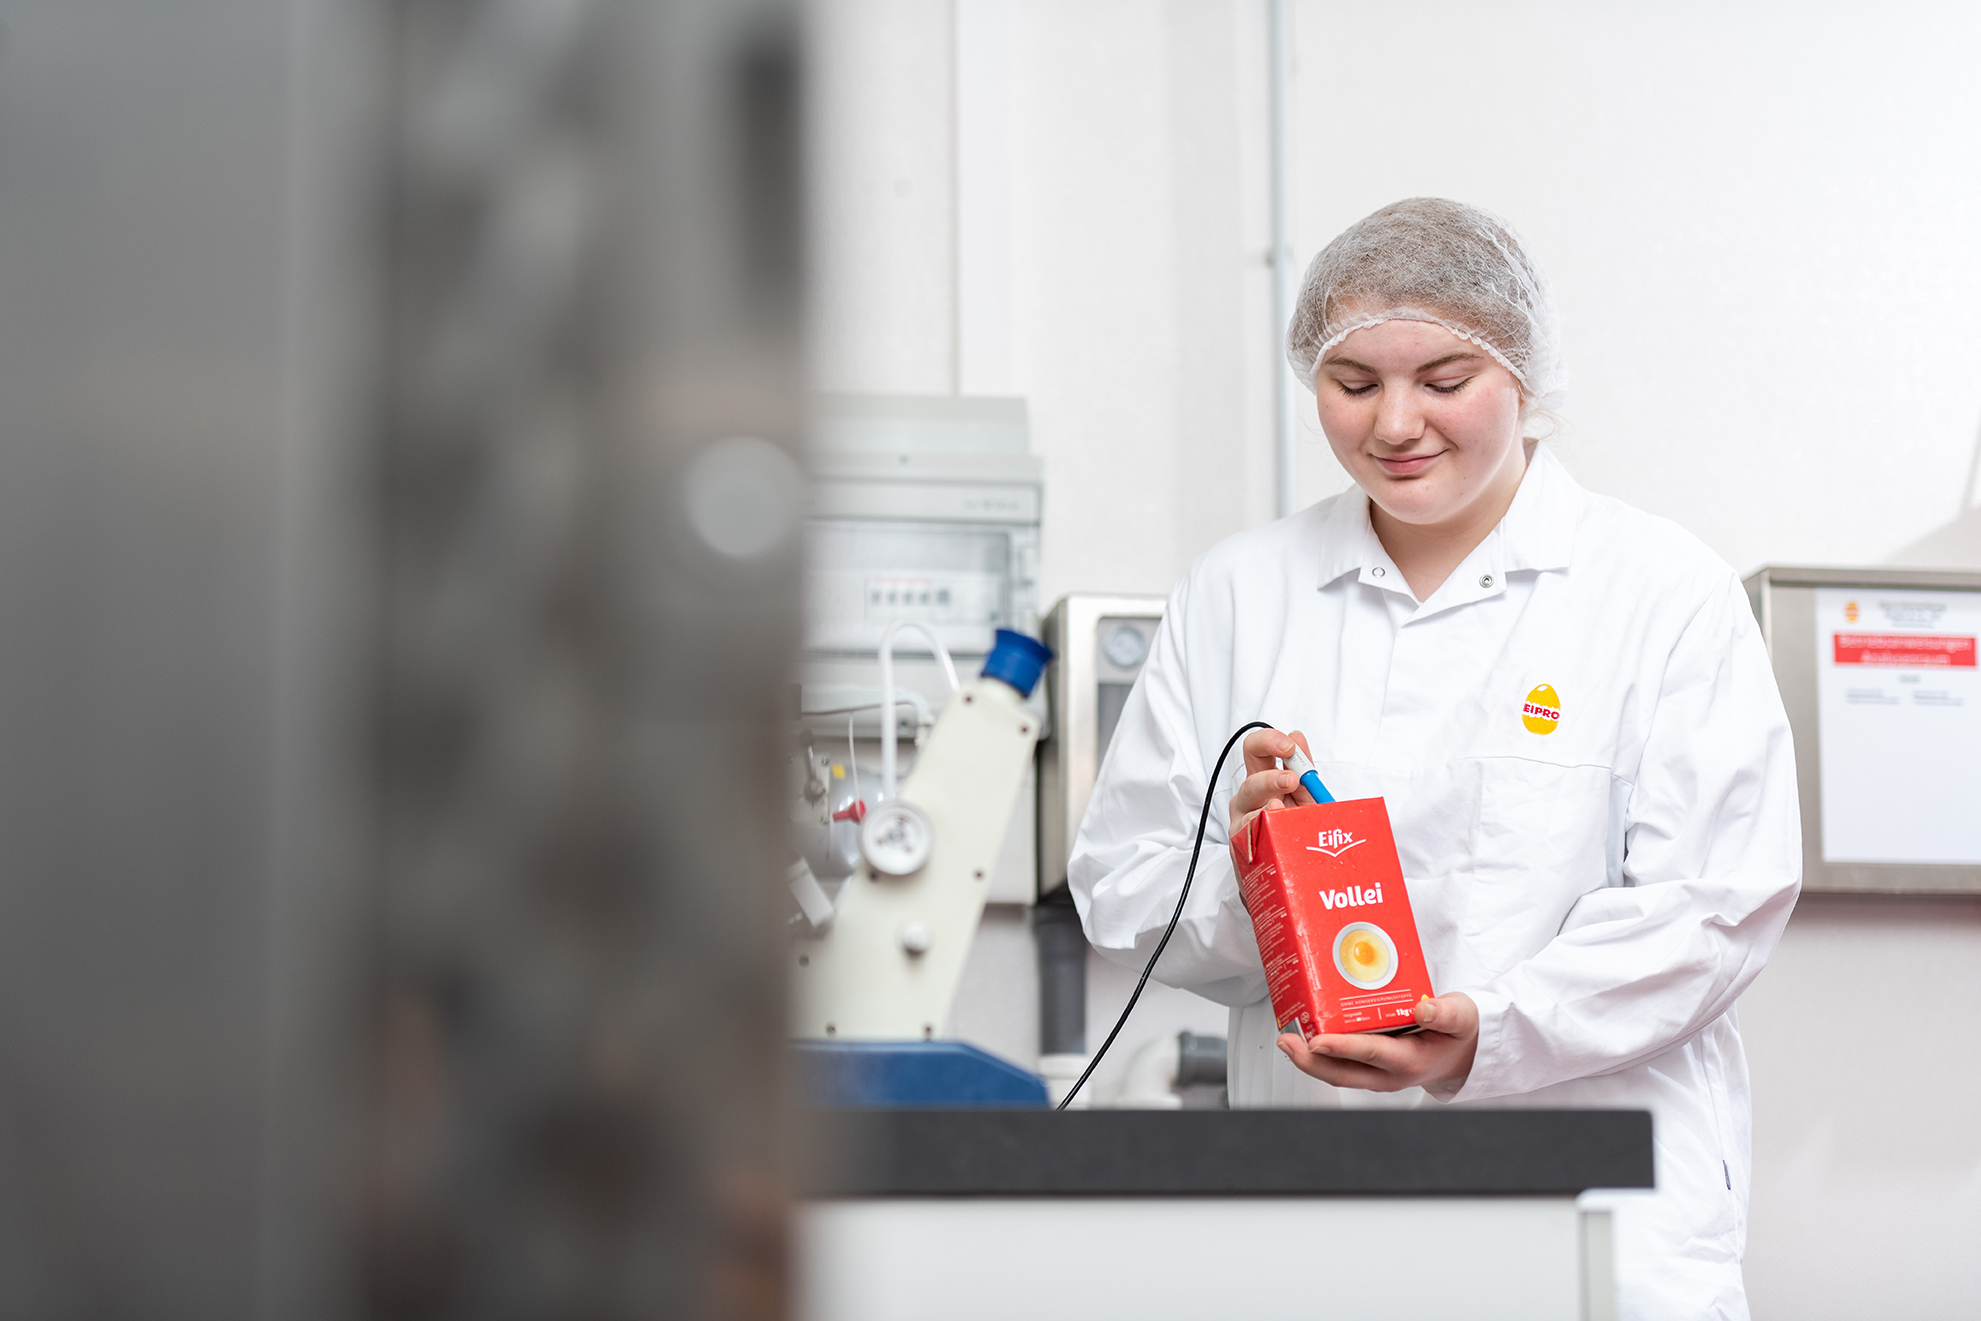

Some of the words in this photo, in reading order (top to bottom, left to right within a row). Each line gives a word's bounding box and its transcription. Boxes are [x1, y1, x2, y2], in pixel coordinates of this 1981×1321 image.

[1523, 703, 1560, 720] EIPRO
[1318, 828, 1353, 849] Eifix
[1319, 882, 1383, 910] Vollei
[1355, 993, 1412, 1004] KONSERVIERUNGSSTOFFE
